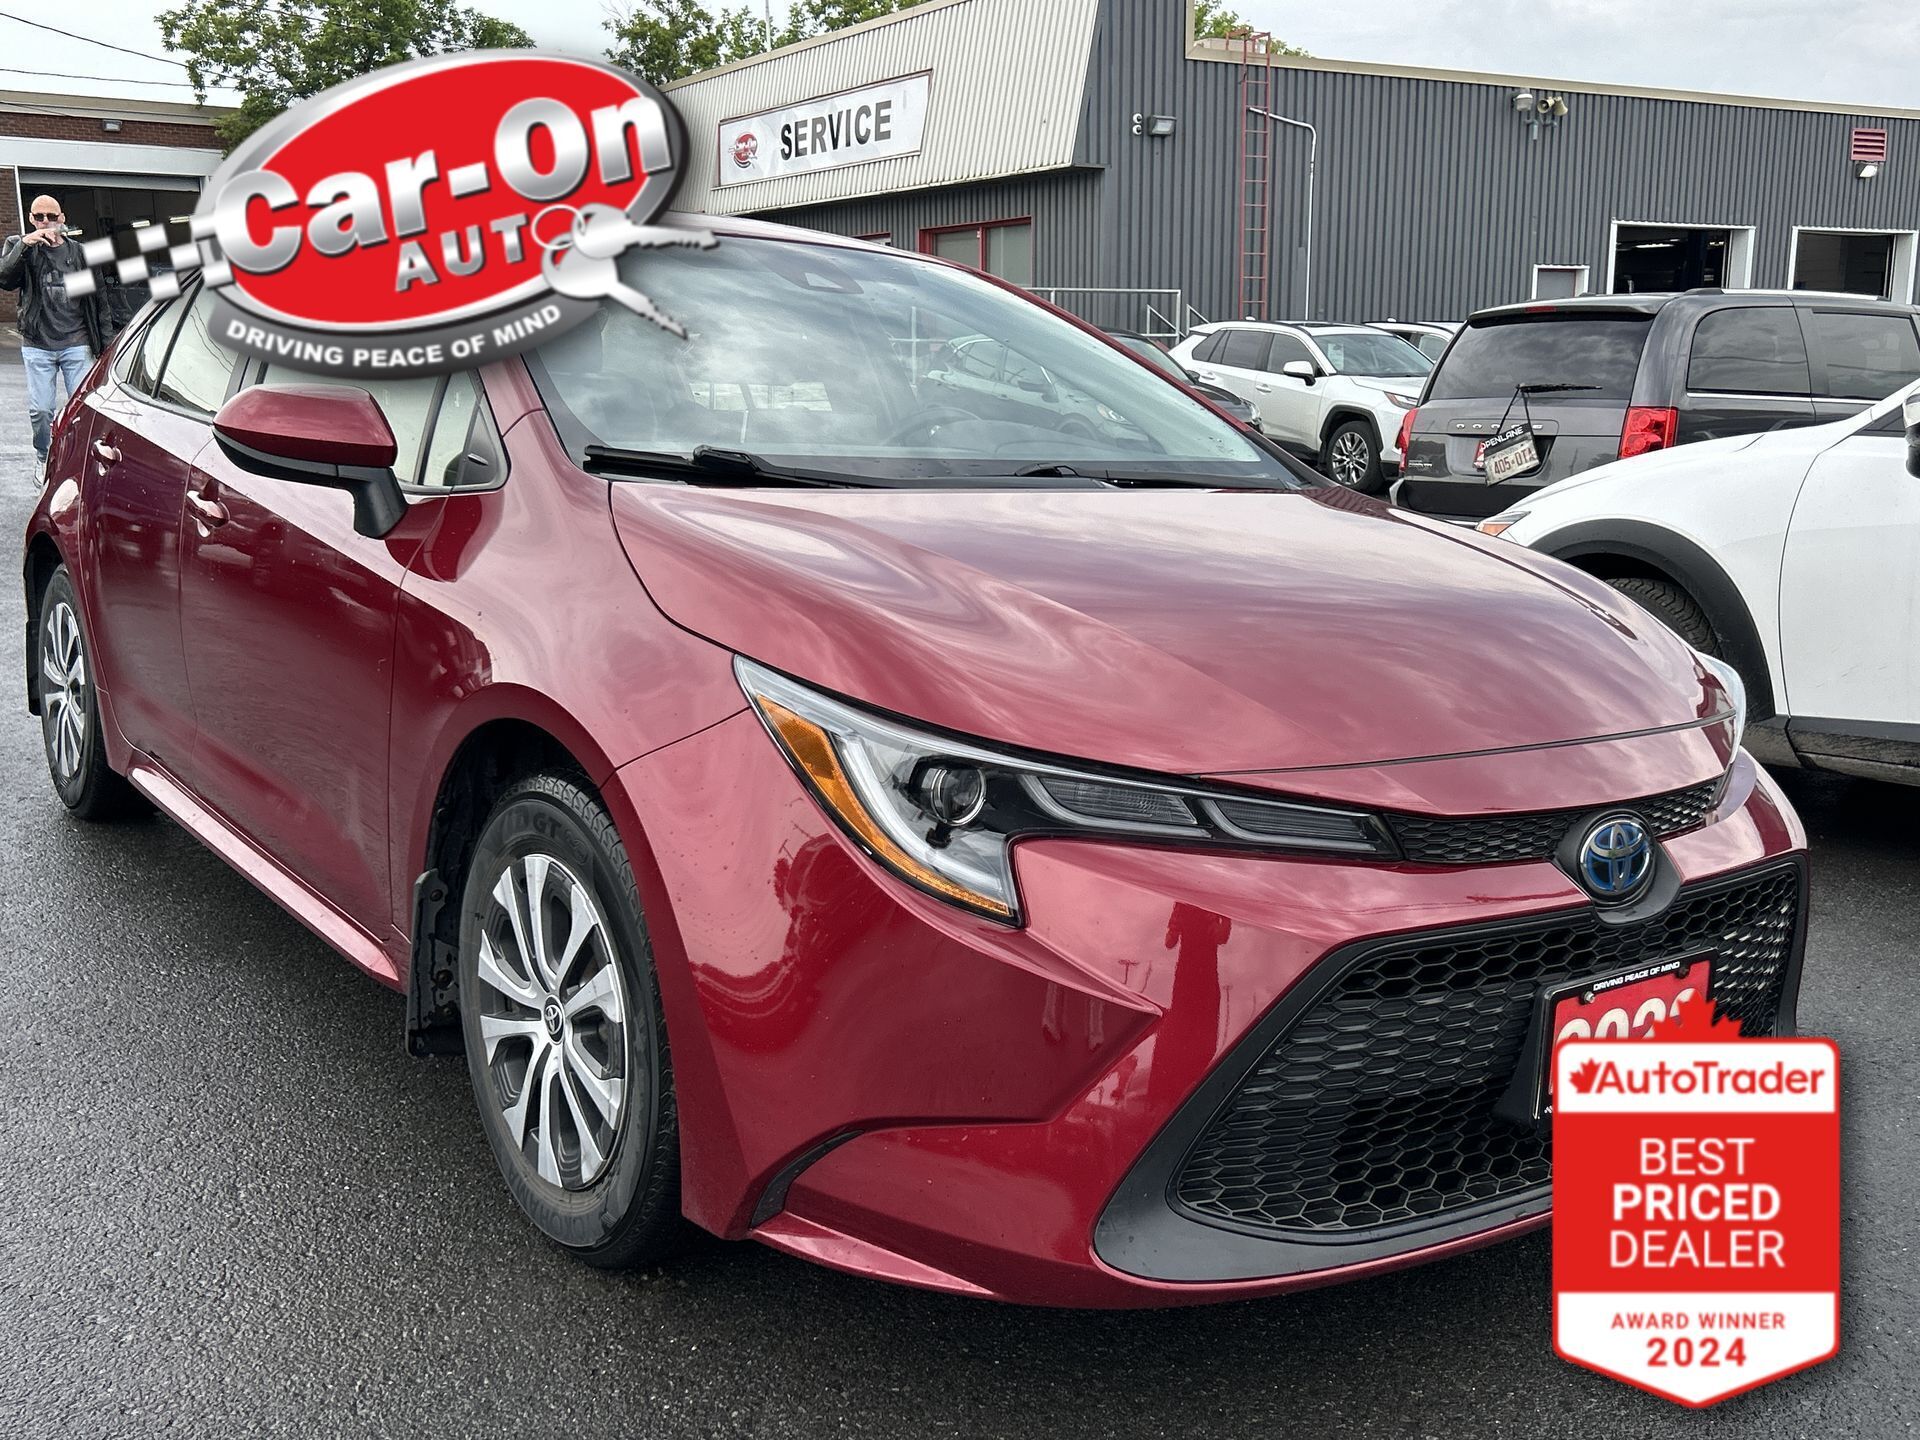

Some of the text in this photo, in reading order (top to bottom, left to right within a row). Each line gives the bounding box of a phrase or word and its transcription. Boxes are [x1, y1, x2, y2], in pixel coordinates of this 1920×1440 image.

[780, 99, 892, 161] SERVICE
[1479, 426, 1524, 450] OPENLANE
[1593, 961, 1681, 991] DRIVING PEACE OF MIND
